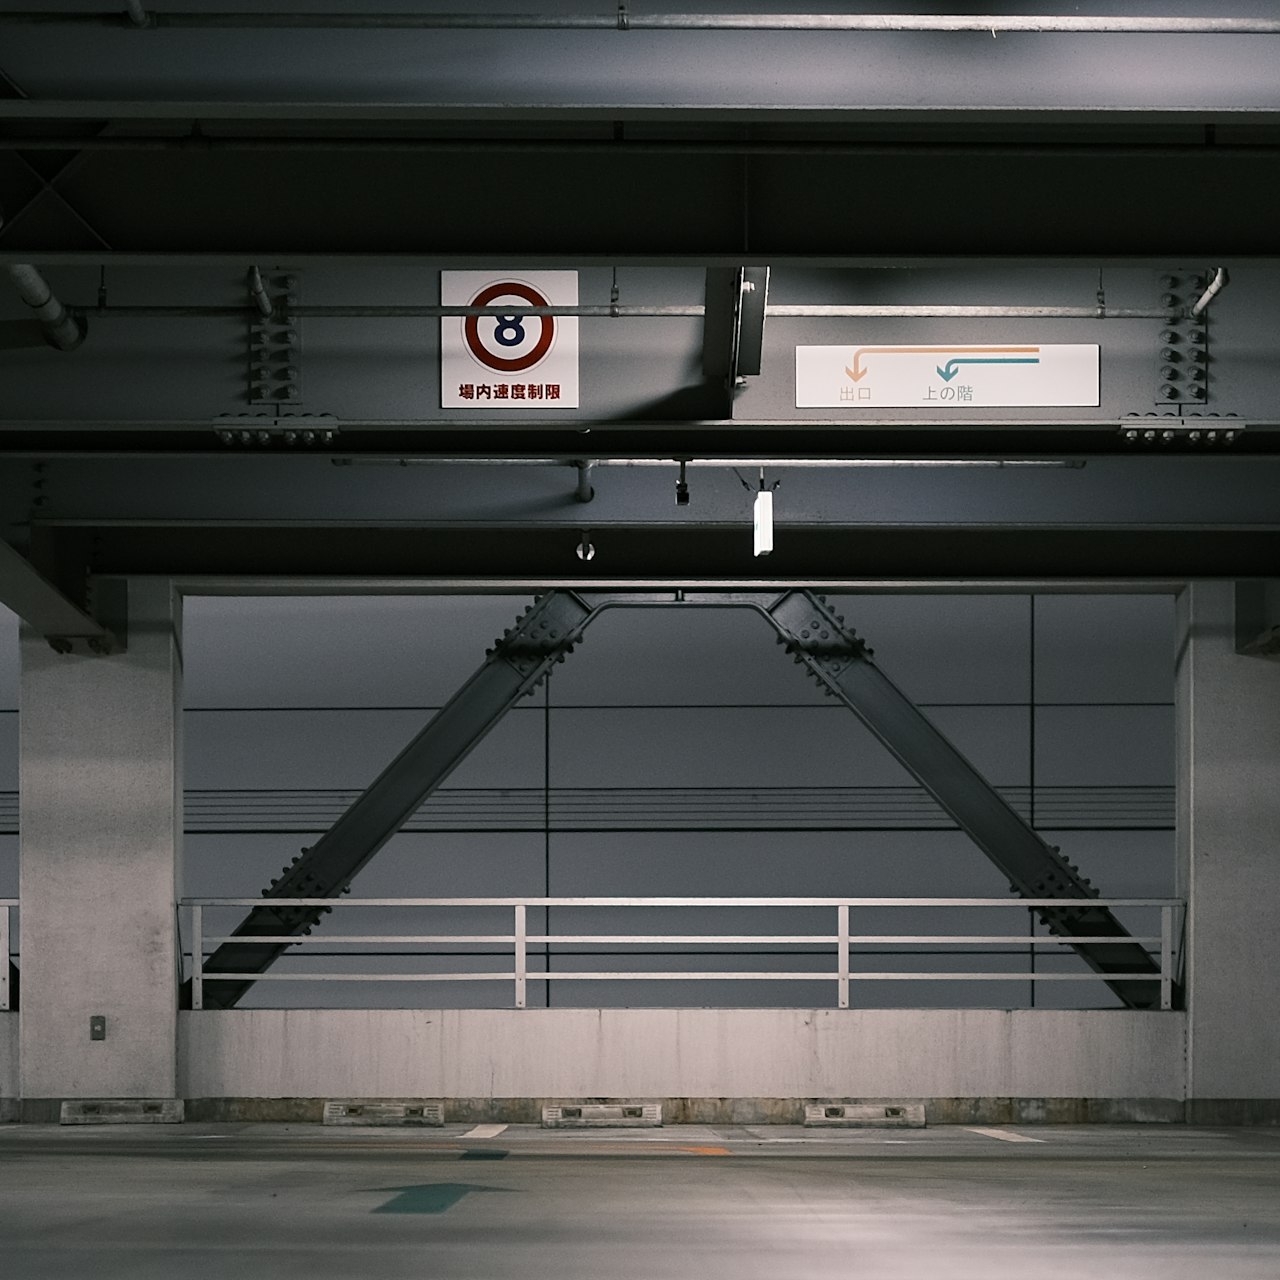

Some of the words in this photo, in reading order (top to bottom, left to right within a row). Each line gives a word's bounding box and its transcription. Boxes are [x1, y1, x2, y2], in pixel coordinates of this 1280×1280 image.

[494, 305, 525, 347] 8
[458, 384, 561, 400] 場内速度制限
[839, 386, 872, 401] 出口
[922, 385, 974, 402] 上の階
